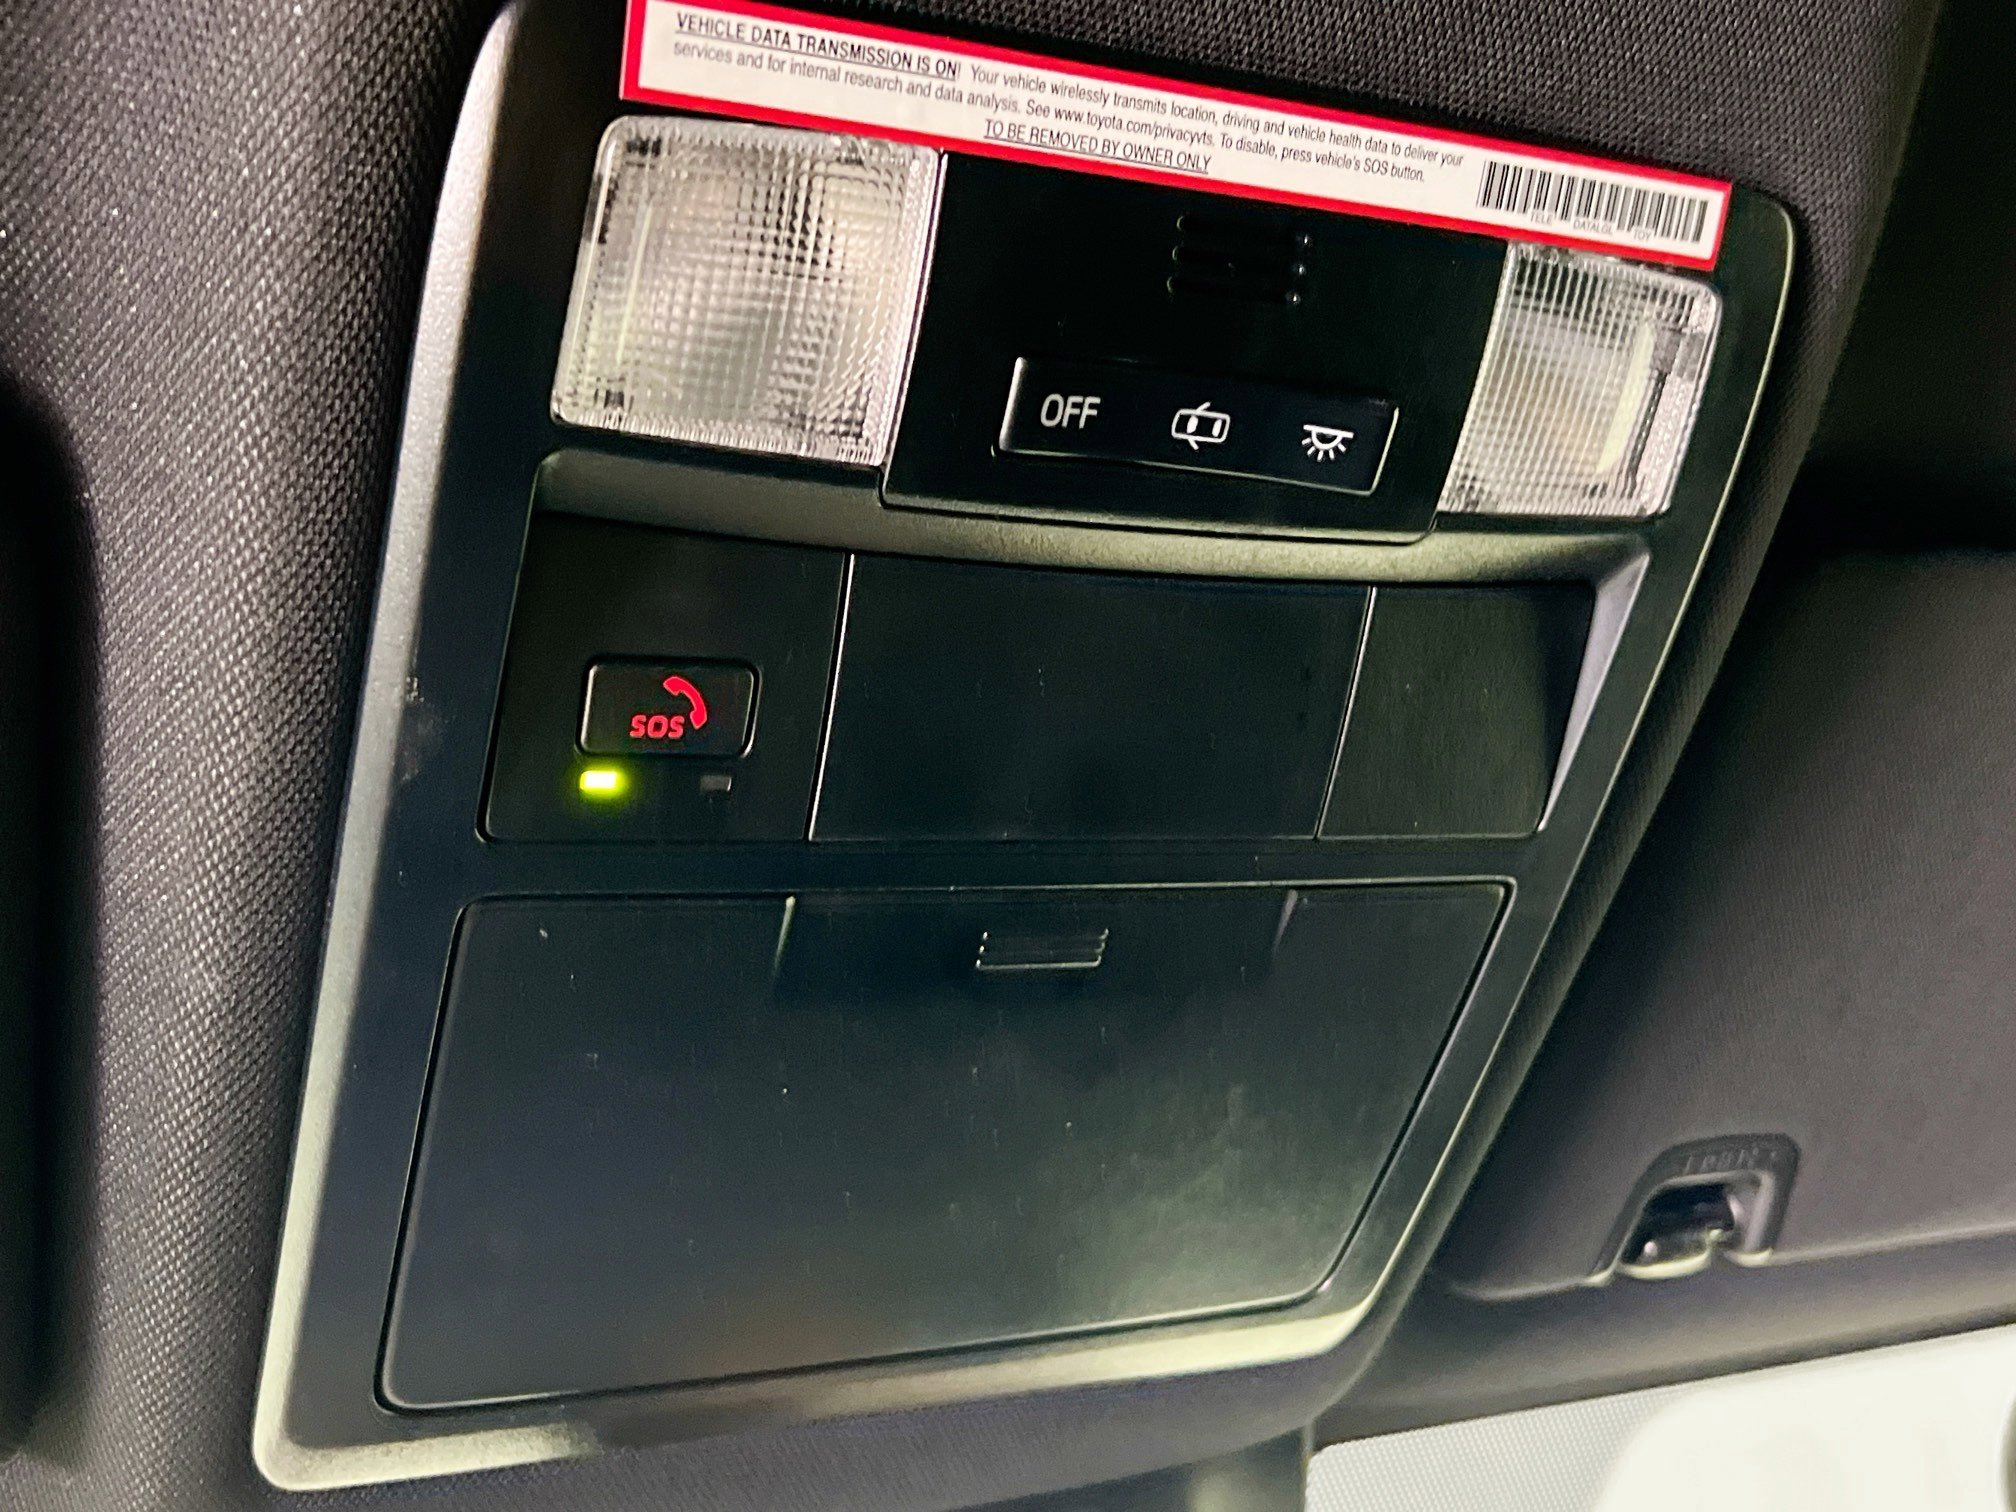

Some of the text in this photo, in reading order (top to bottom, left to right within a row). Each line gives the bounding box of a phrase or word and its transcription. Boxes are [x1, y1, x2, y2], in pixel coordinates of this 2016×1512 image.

[674, 41, 733, 64] services
[737, 51, 763, 69] and
[768, 54, 786, 72] for
[790, 58, 841, 82] internal
[844, 71, 903, 94] research
[906, 79, 932, 98] and
[935, 84, 963, 102] data
[967, 91, 1021, 114] analysis.
[1026, 99, 1051, 118] See
[1221, 132, 1233, 149] To
[1236, 136, 1278, 159] disable,
[1281, 146, 1312, 163] press
[1316, 152, 1361, 171] vehicle's
[1364, 158, 1389, 175] SOS
[1391, 165, 1425, 182] button.
[677, 12, 745, 40] VEHICLE
[751, 25, 791, 50] DATA
[798, 33, 912, 71] TRANSMISSION
[917, 55, 930, 74] IS
[971, 63, 999, 82] Your
[1003, 74, 1046, 93] vehicle
[1051, 80, 1110, 108] wirelessly
[1114, 92, 1167, 115] transmits
[1171, 101, 1218, 126] location,
[1222, 110, 1260, 134] driving
[1263, 119, 1284, 136] and
[1288, 123, 1326, 143] vehicle
[1329, 129, 1362, 149] health
[1365, 136, 1388, 154] data
[1391, 141, 1401, 155] to
[1404, 143, 1438, 162] deliver
[1441, 152, 1464, 168] your
[985, 119, 1212, 171] TO BE REMOVED BY OWNER ONLY
[1040, 393, 1100, 429] OFF
[630, 714, 685, 739] SOS
